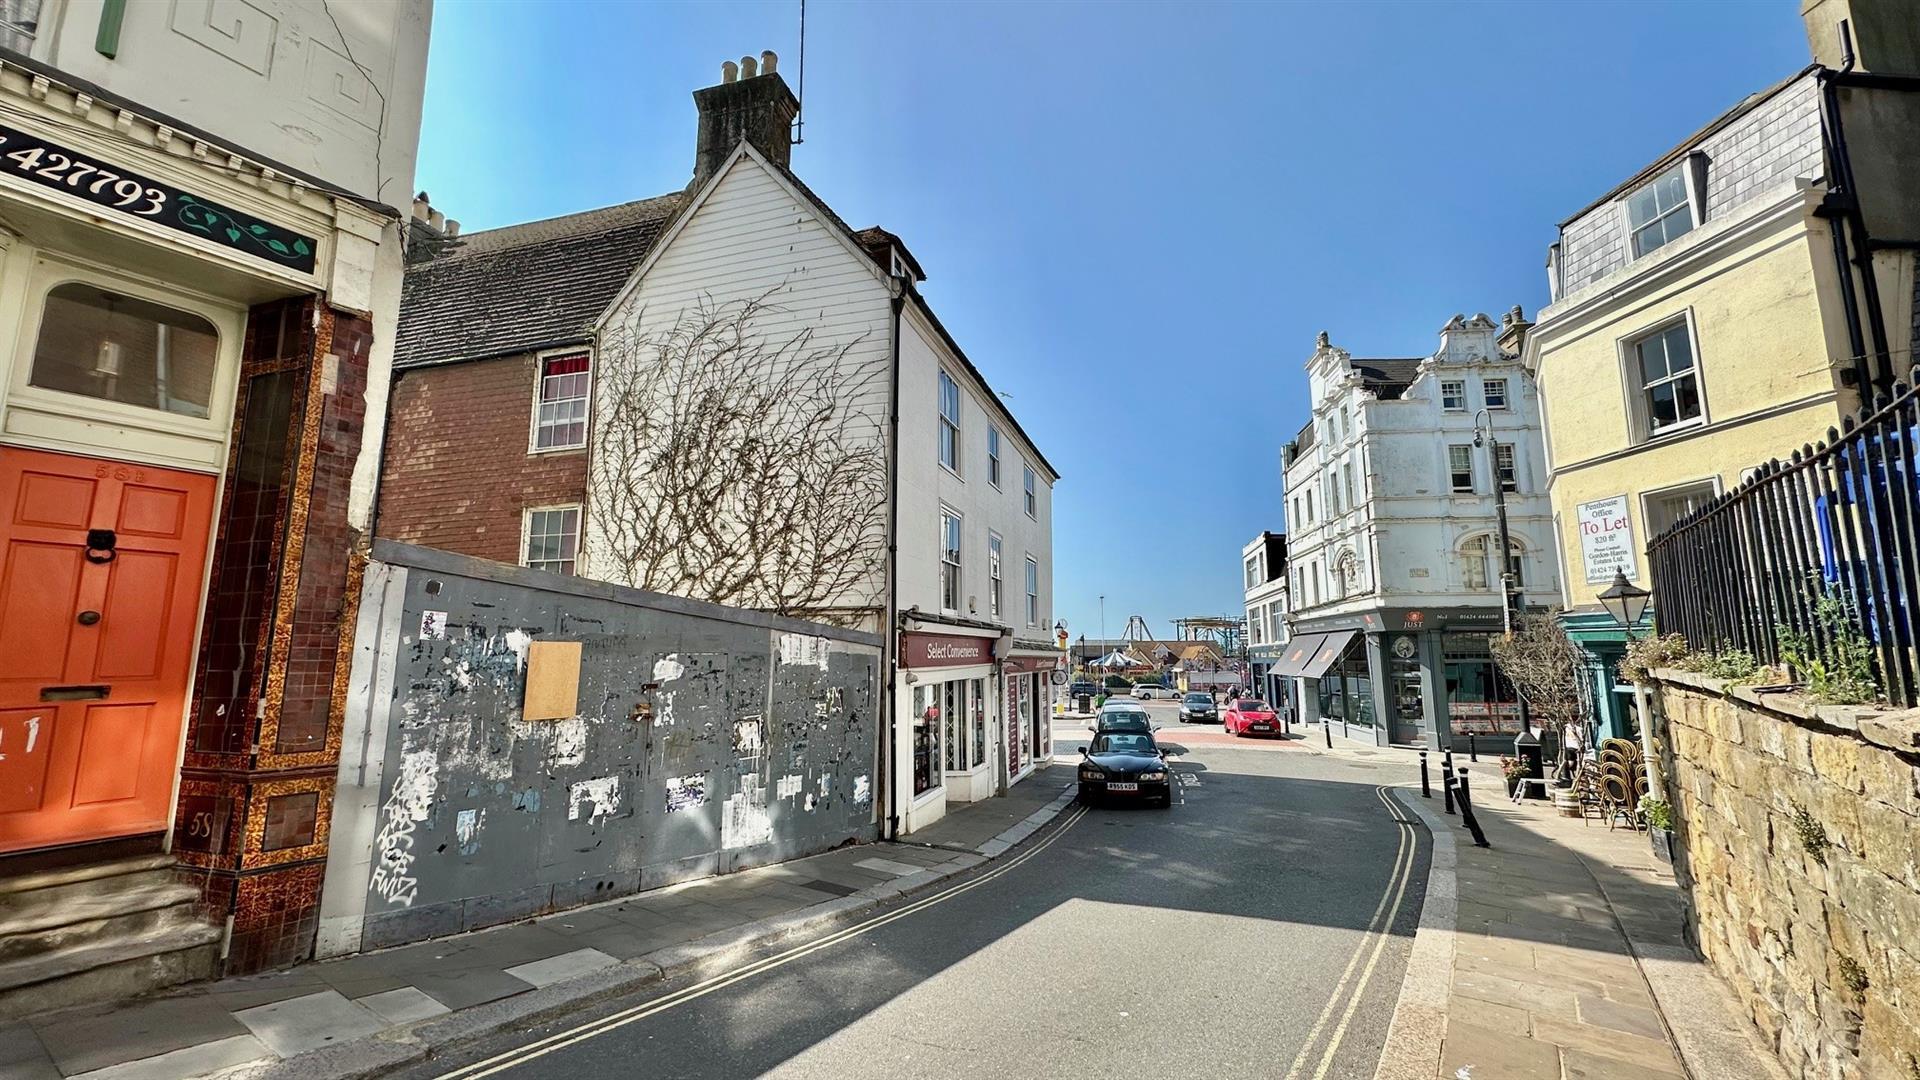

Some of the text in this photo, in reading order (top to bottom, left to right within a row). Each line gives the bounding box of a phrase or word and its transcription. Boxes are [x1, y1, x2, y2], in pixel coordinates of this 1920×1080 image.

[6, 148, 167, 216] 427793
[1585, 500, 1617, 511] Penthouse
[1592, 510, 1612, 518] Office
[1581, 517, 1628, 535] To Let
[1403, 621, 1424, 629] JUST
[927, 643, 979, 659] Select Convenience
[189, 812, 213, 838] 58
